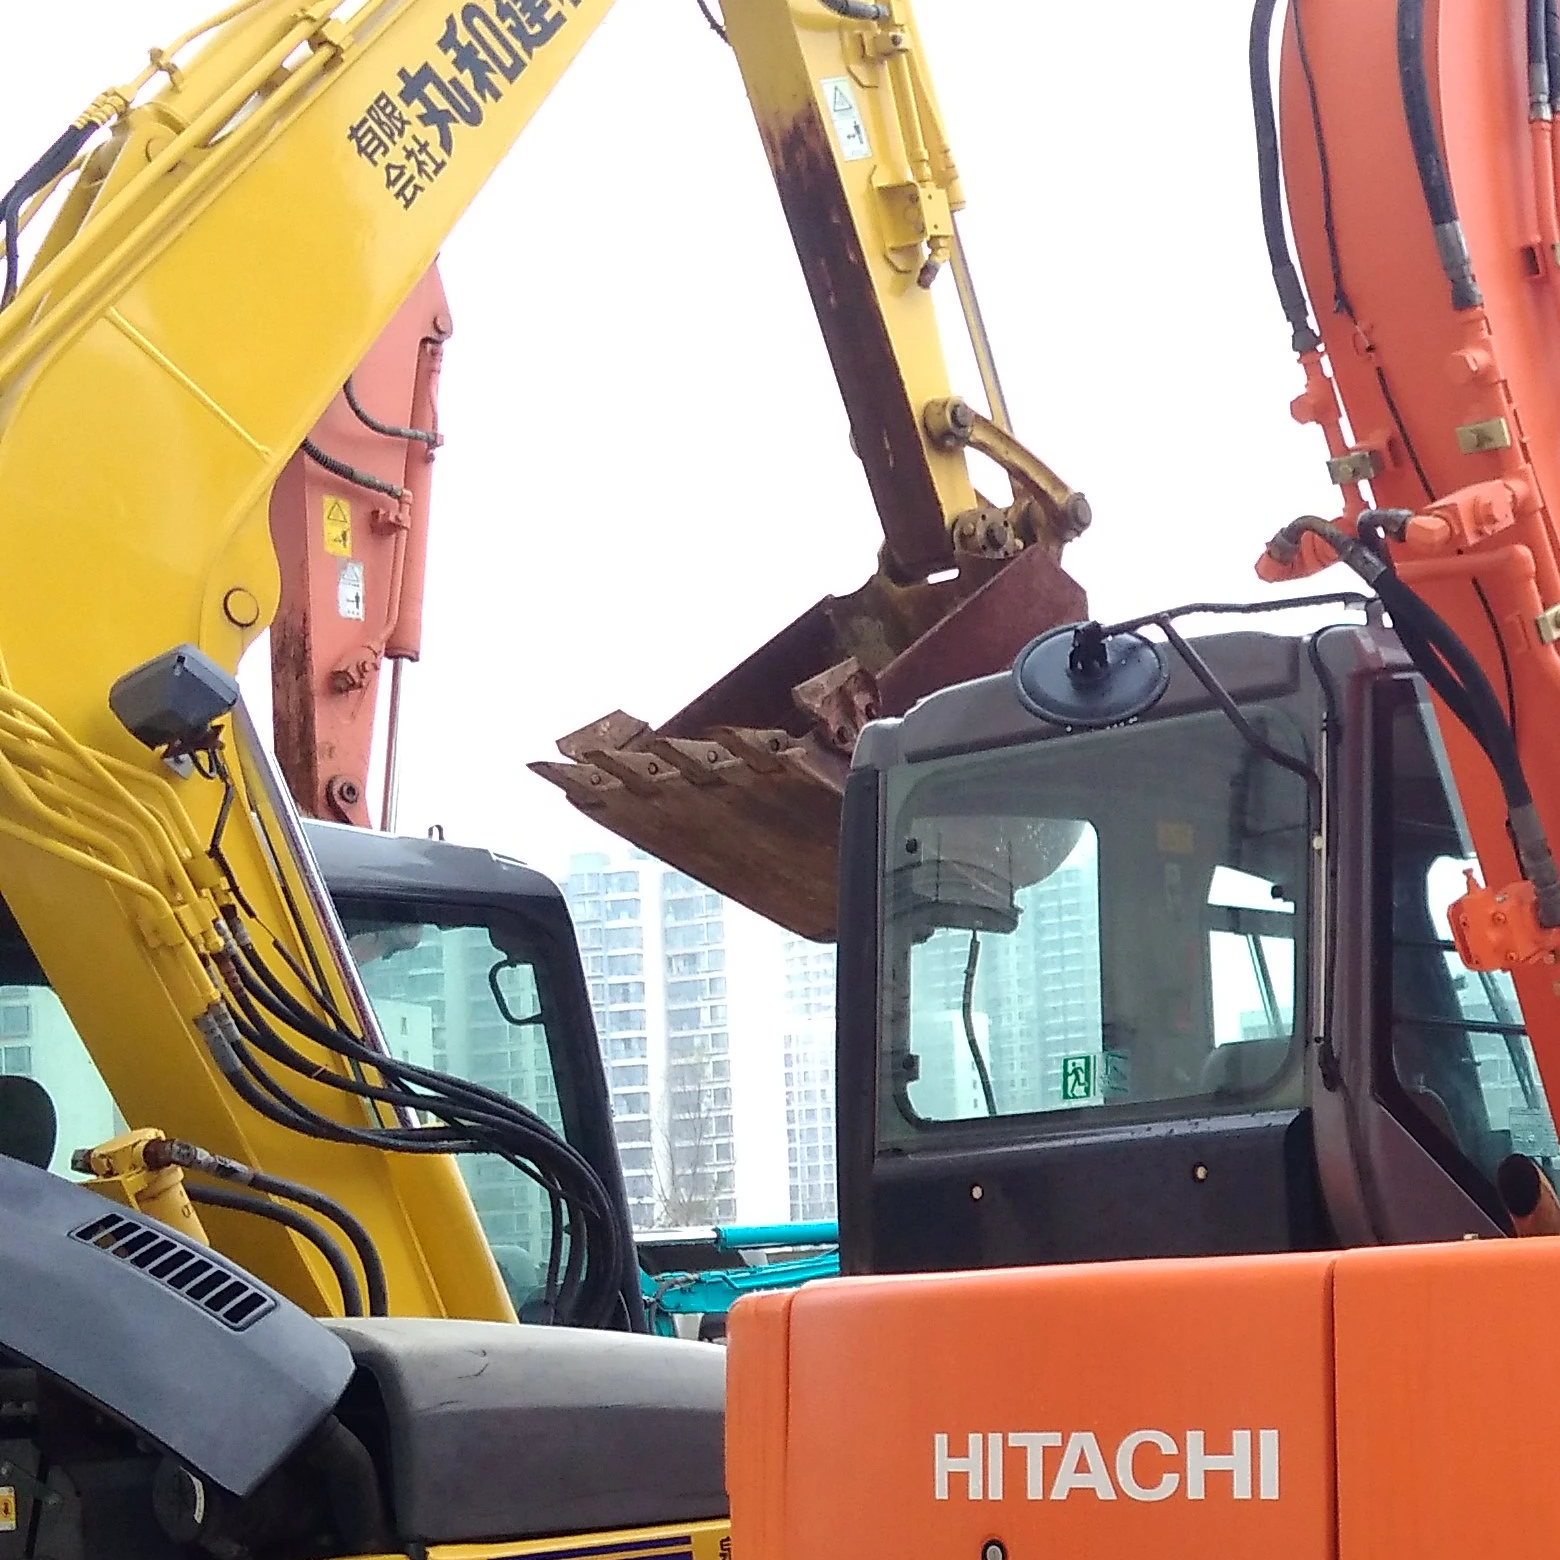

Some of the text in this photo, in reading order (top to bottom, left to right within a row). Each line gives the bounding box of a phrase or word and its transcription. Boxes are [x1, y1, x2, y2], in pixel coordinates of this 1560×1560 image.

[396, 0, 585, 158] 丸和建
[347, 90, 412, 166] 有限
[384, 134, 447, 211] 会社
[933, 1428, 1280, 1502] HITACHI
